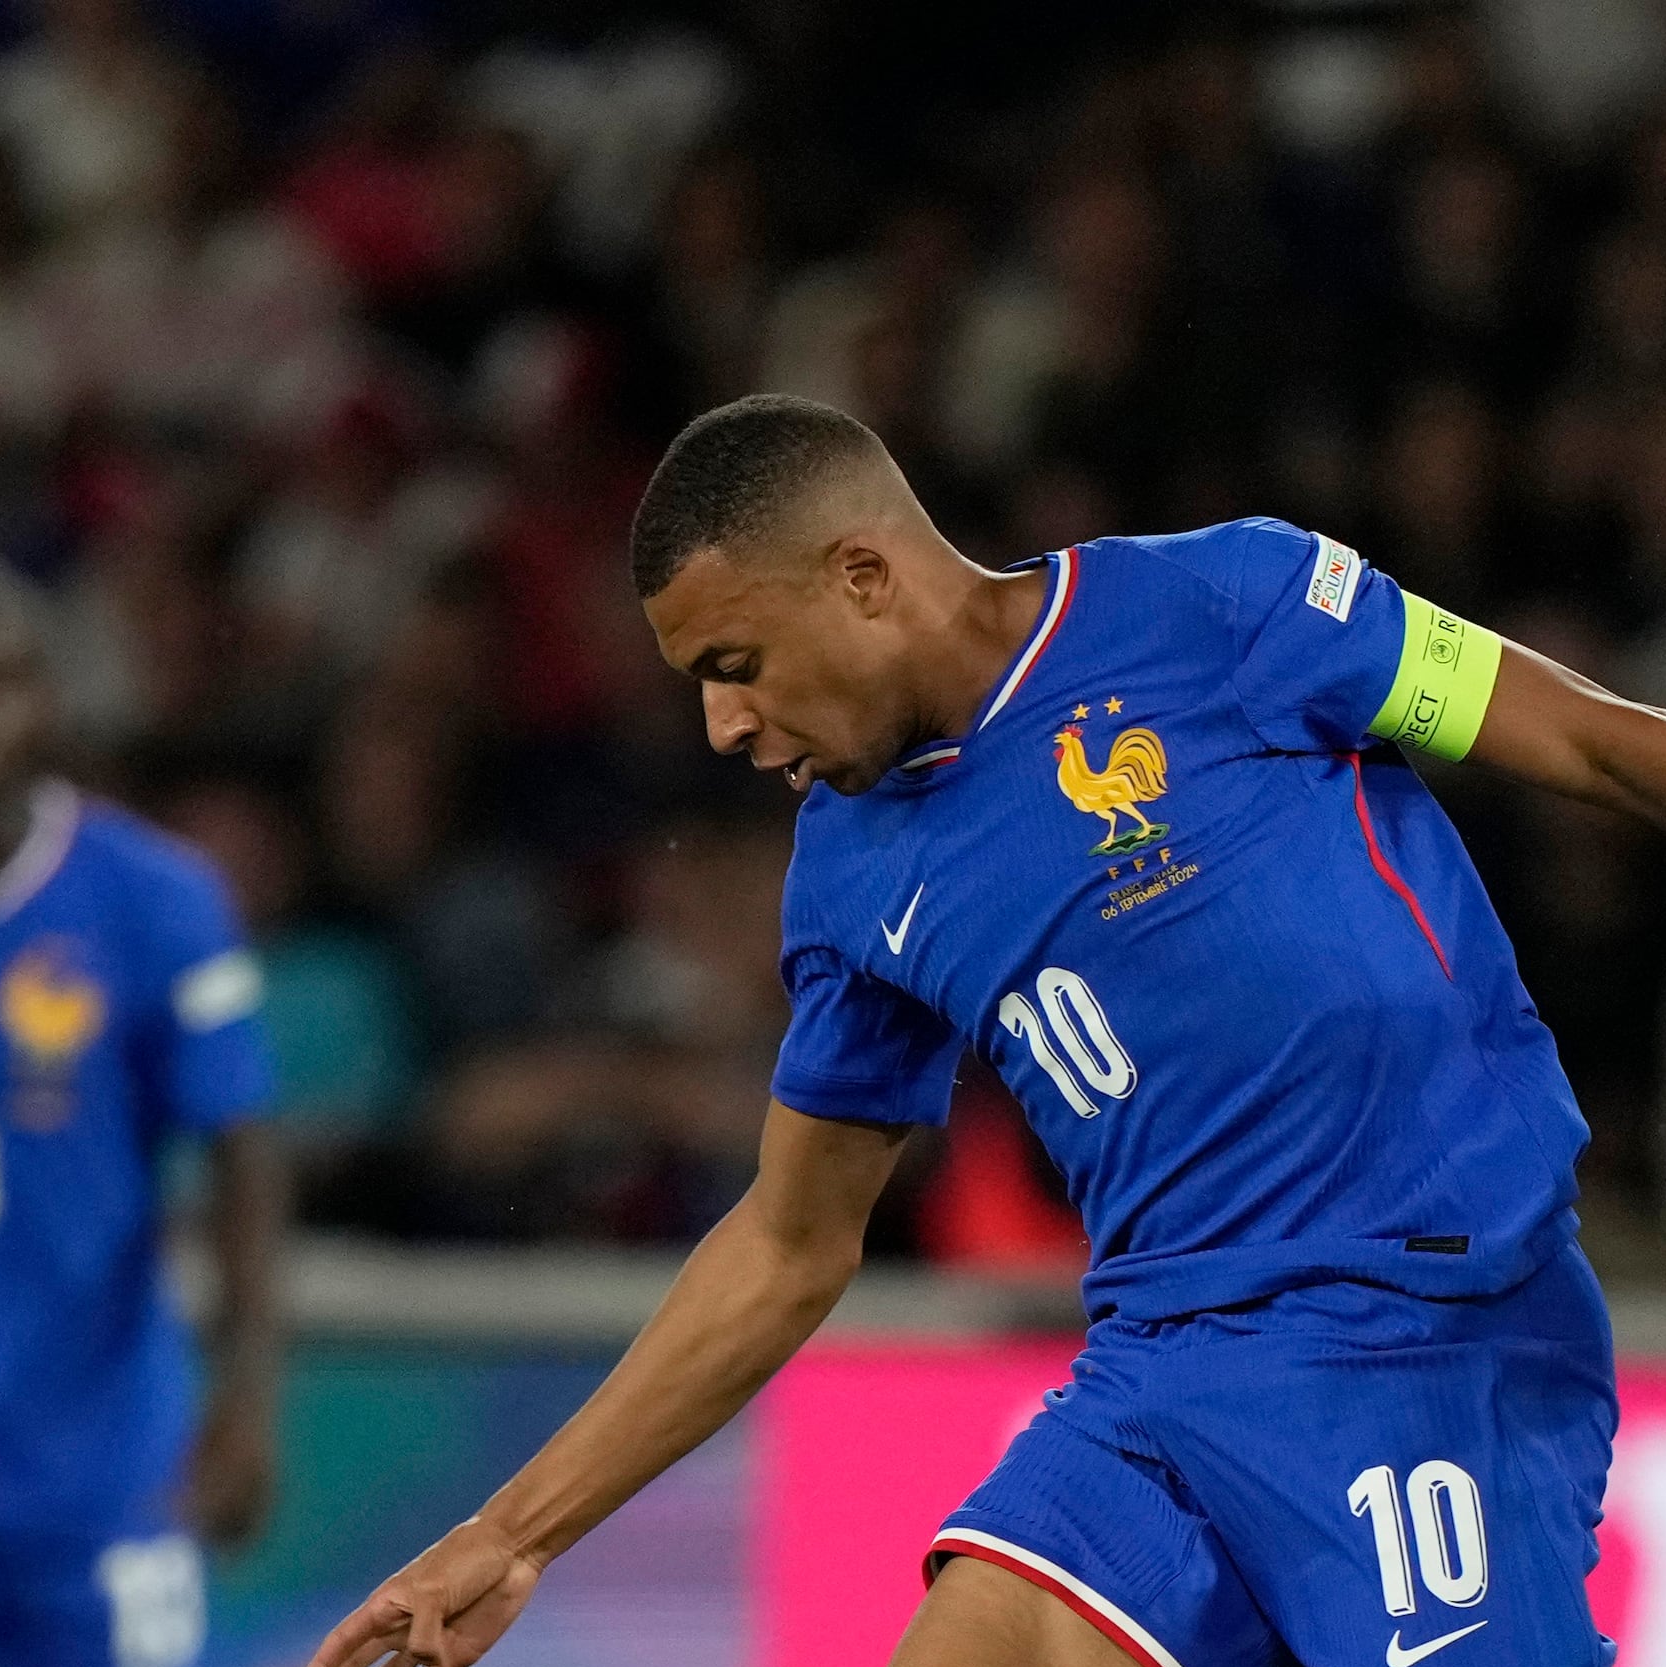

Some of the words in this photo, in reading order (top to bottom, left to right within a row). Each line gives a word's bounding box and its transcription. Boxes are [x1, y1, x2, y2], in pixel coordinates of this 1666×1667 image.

[1310, 578, 1324, 604] UEFA
[1101, 905, 1118, 920] 06
[1119, 880, 1169, 912] SEPTEMBRE
[1168, 864, 1199, 887] 2024
[998, 967, 1137, 1119] 10
[1347, 1460, 1488, 1617] 10
